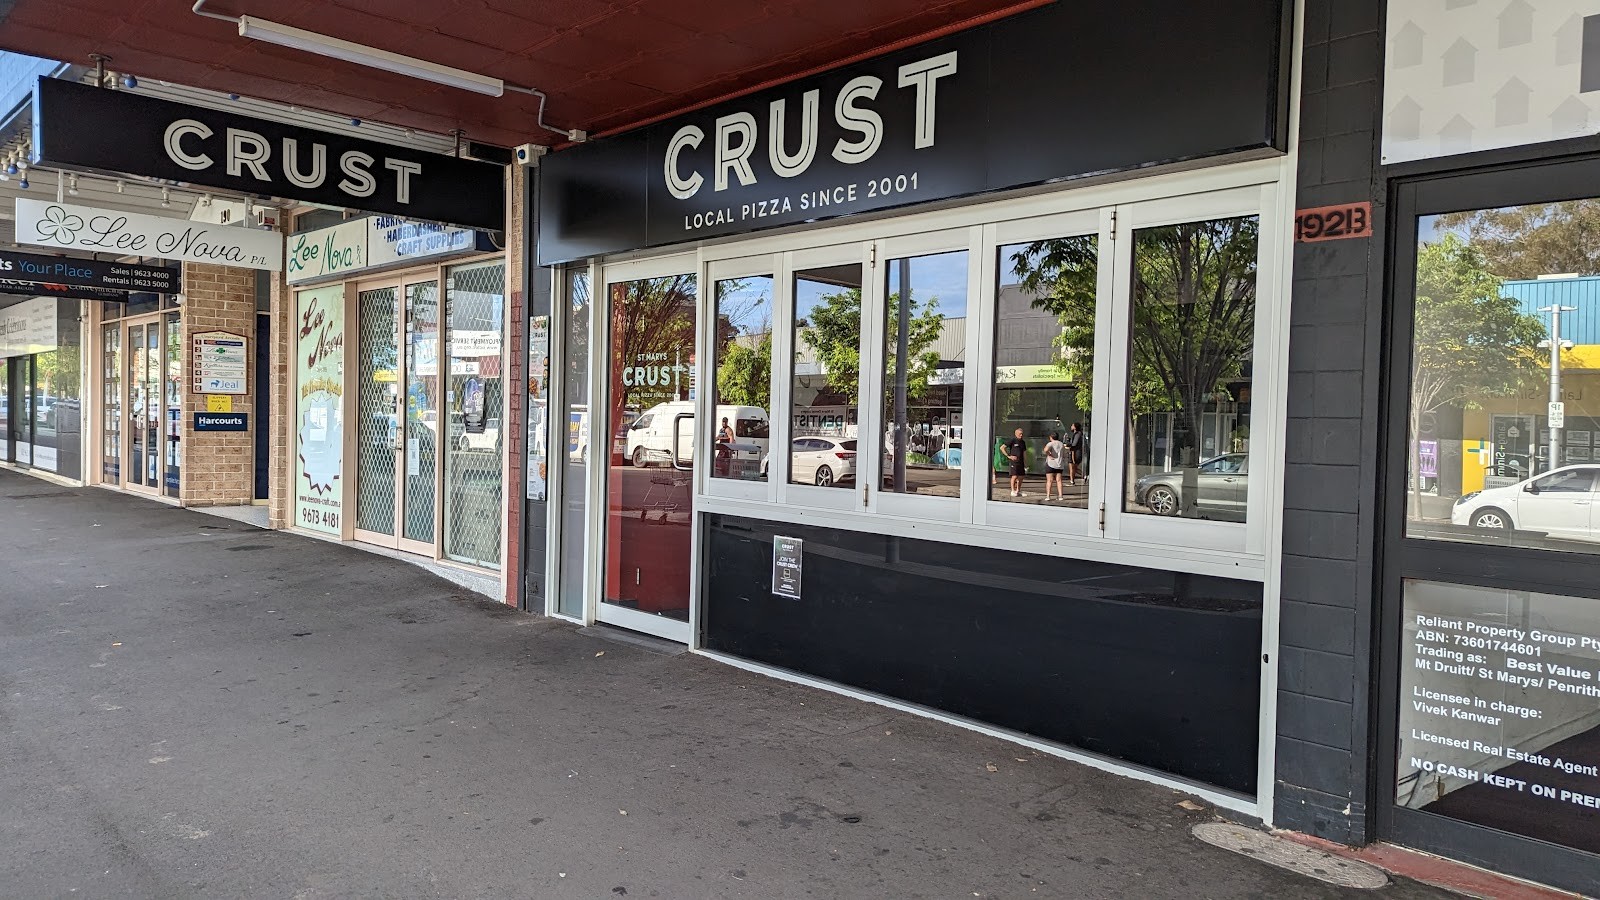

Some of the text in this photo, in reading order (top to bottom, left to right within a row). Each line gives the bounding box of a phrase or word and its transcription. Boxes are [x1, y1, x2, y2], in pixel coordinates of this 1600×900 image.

[664, 50, 958, 200] CRUST
[164, 118, 422, 205] CRUST
[685, 172, 919, 230] LOCAL PIZZA SINCE 2001
[80, 215, 267, 266] Lee Nova P/L
[289, 234, 319, 273] Lee
[319, 230, 353, 276] Nova
[397, 230, 465, 257] CRAFT SUPPLIES
[18, 260, 51, 275] Your
[55, 263, 93, 279] Place
[102, 275, 169, 289] Rentals 9623 5000
[110, 267, 169, 280] Sales 9623 4000
[300, 297, 326, 341] Lee
[308, 320, 343, 369] Nova
[637, 352, 668, 361] ST MARYS
[220, 380, 239, 389] Jeal
[622, 365, 684, 387] CRUST
[199, 417, 243, 426] Harcourts
[303, 507, 339, 529] 9673 4181
[1415, 630, 1541, 657] ABN: 73601744601
[1416, 615, 1463, 631] Reliant
[1466, 621, 1526, 641] Property
[1530, 630, 1576, 648] Group
[1415, 644, 1464, 663] Trading
[1467, 653, 1487, 664] as:
[1506, 657, 1543, 673] Best
[1546, 663, 1592, 680] Value
[1415, 658, 1600, 698] Mt Druitt/ St Marys/ Penrith
[1412, 700, 1501, 726] Vivek Kanwar
[1413, 685, 1542, 719] Licensee in charge:
[1411, 728, 1599, 777] Licensed Real Estate Agent
[1411, 757, 1434, 772] NO
[1436, 763, 1479, 782] CASH
[1483, 773, 1527, 792] KEPT
[1531, 784, 1556, 799] ON
